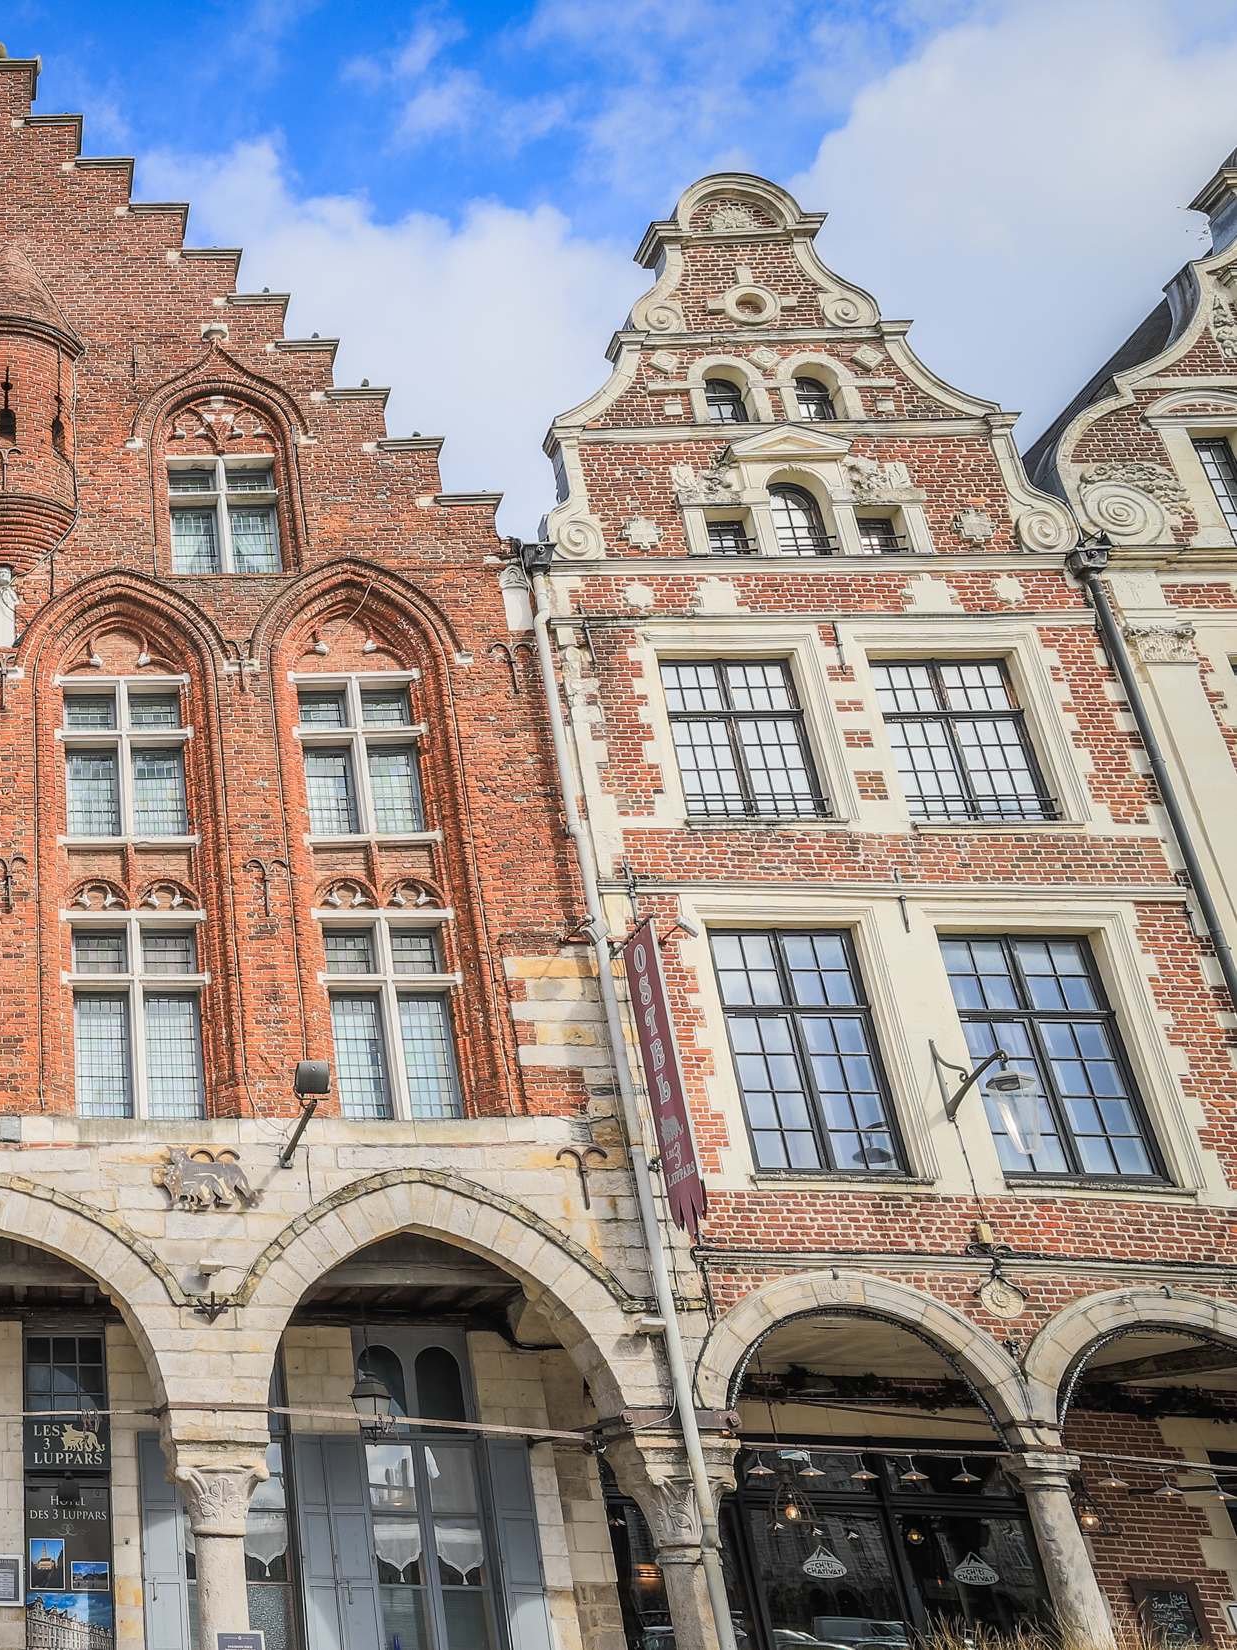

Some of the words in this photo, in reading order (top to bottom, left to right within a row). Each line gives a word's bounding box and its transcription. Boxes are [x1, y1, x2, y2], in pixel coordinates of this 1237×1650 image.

[633, 943, 671, 1104] OSTEL
[673, 1141, 682, 1169] 3
[666, 1160, 696, 1188] LUPPARS
[33, 1424, 60, 1437] LES
[43, 1437, 51, 1450] 3
[33, 1452, 103, 1465] LUPPARS
[29, 1509, 49, 1519] DES
[52, 1508, 59, 1520] 3
[62, 1509, 107, 1520] LUPPARS
